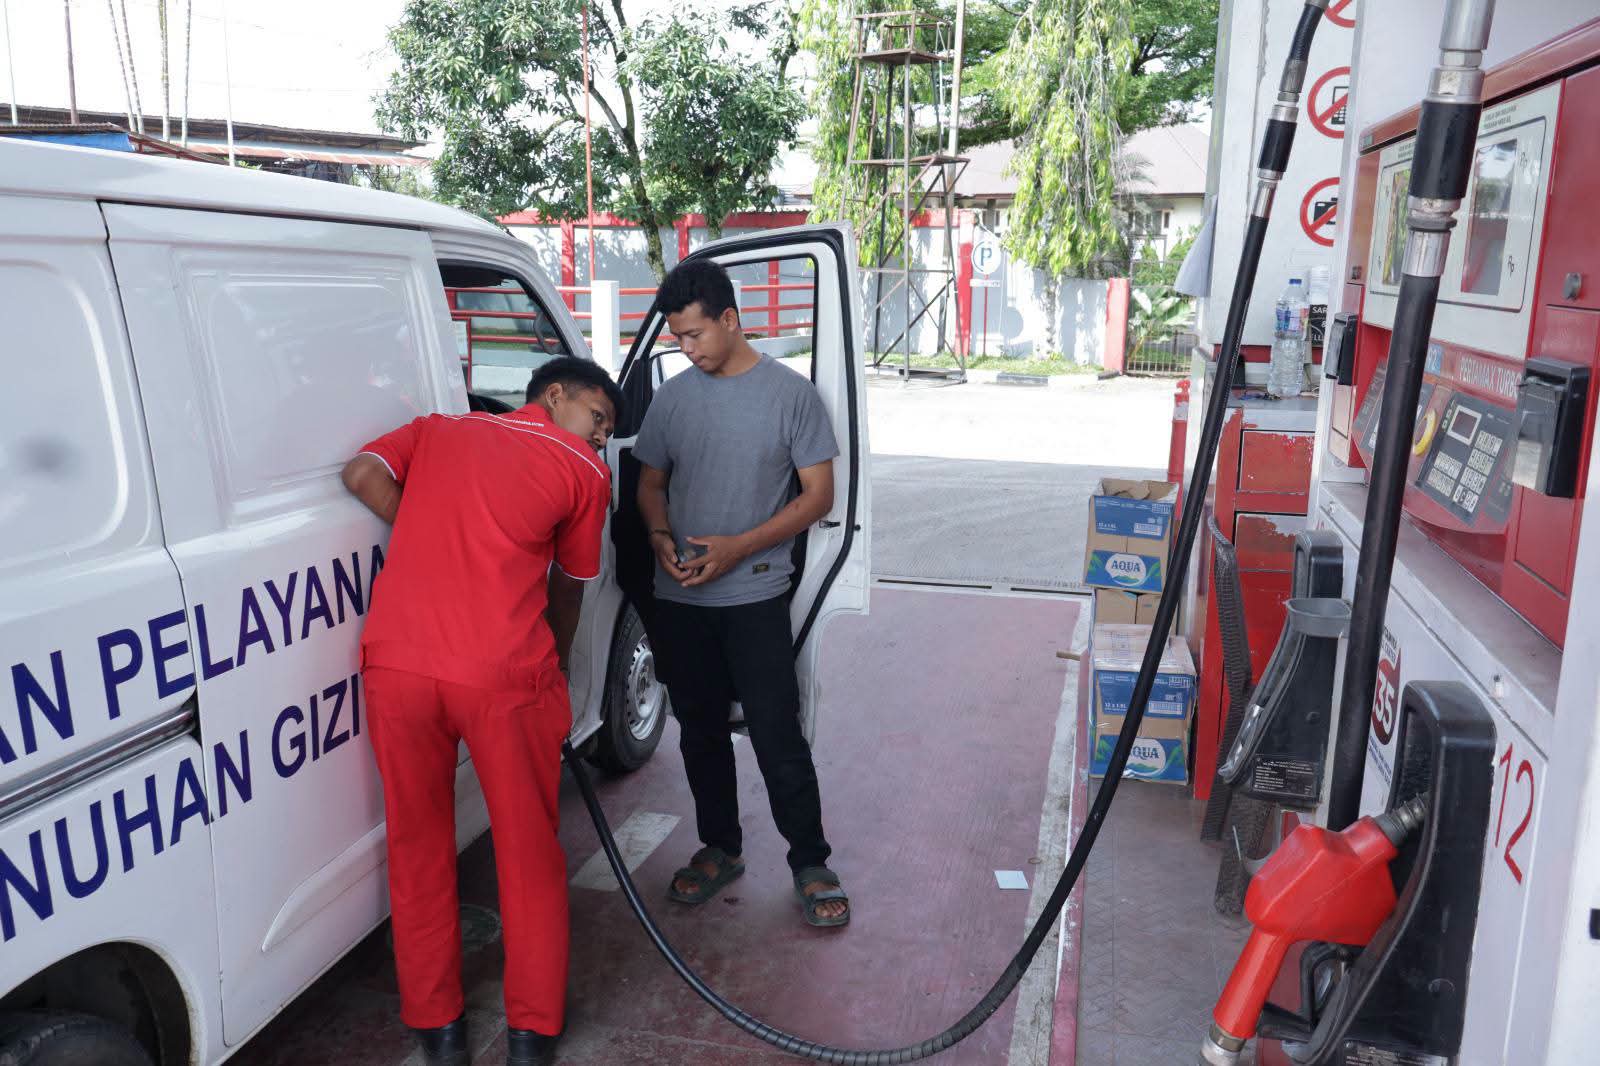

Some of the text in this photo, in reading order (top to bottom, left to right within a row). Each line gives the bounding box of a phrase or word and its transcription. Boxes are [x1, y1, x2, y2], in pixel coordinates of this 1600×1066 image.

[980, 247, 992, 266] P
[1111, 560, 1141, 573] AQUA
[1375, 669, 1395, 736] 35
[271, 672, 361, 779] GIZI
[1131, 746, 1160, 760] QUA
[1494, 742, 1535, 885] 12
